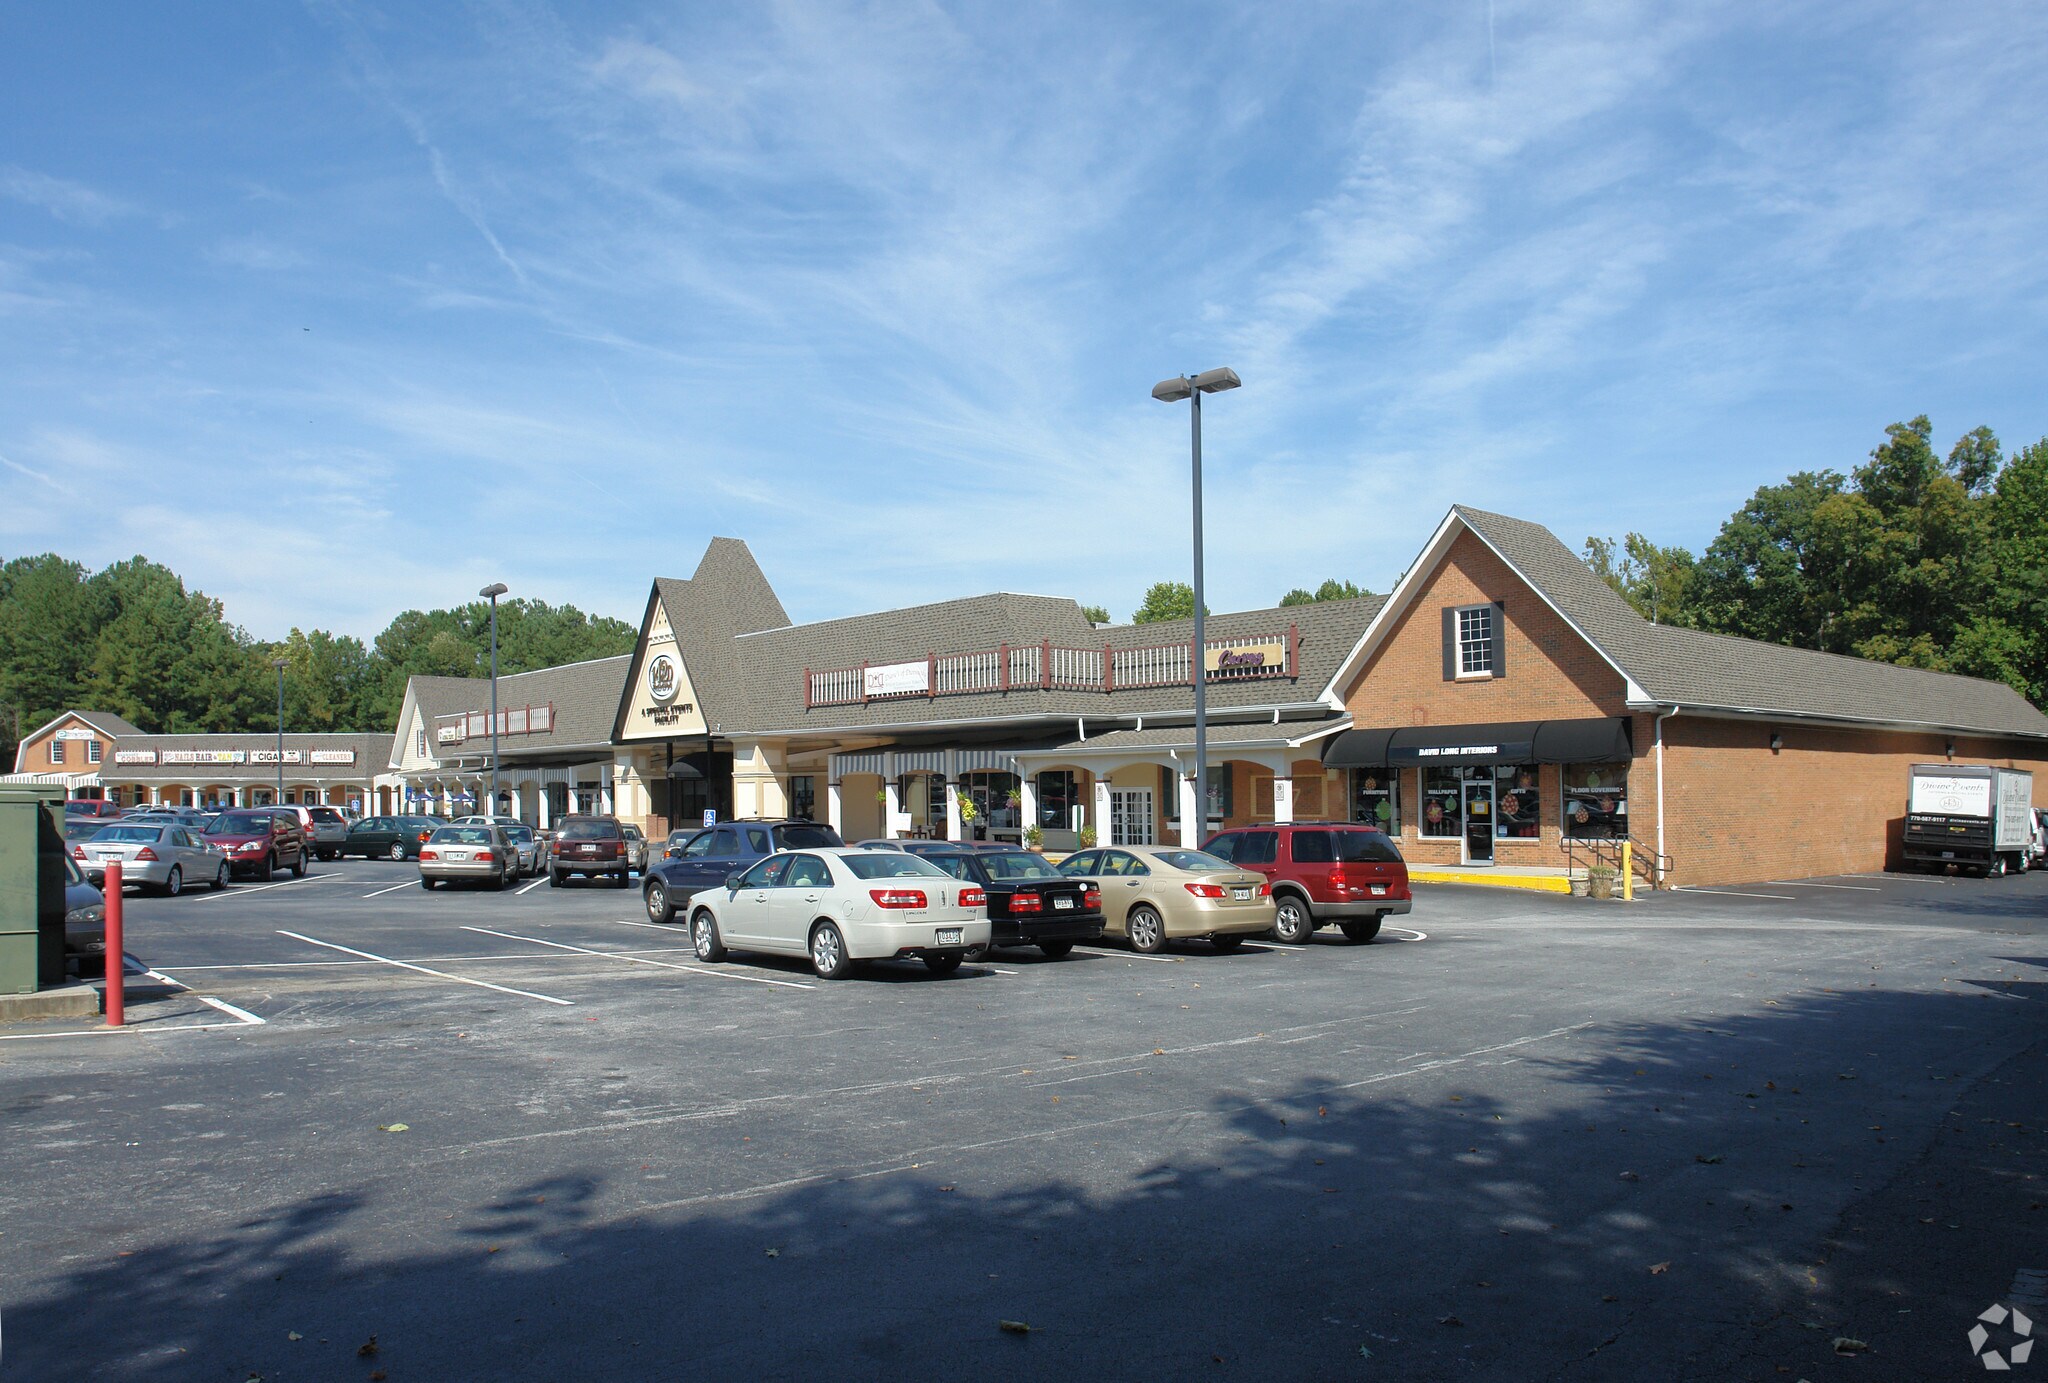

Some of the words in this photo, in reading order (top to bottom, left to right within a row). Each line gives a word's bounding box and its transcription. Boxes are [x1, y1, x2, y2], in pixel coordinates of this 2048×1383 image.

[1218, 649, 1264, 667] Curves
[646, 706, 670, 715] SPECIAL
[671, 703, 693, 713] EVENTS
[654, 715, 679, 724] FACILITY
[1418, 748, 1440, 756] DAVID
[1440, 747, 1460, 755] LONG
[1460, 746, 1498, 755] INTERIORS
[174, 753, 194, 761] NAILS
[195, 753, 213, 761] HAIR
[217, 753, 232, 761] TAN
[322, 753, 352, 761] CLEANERS
[1920, 781, 1951, 791] Divine
[1951, 781, 1984, 791] Events
